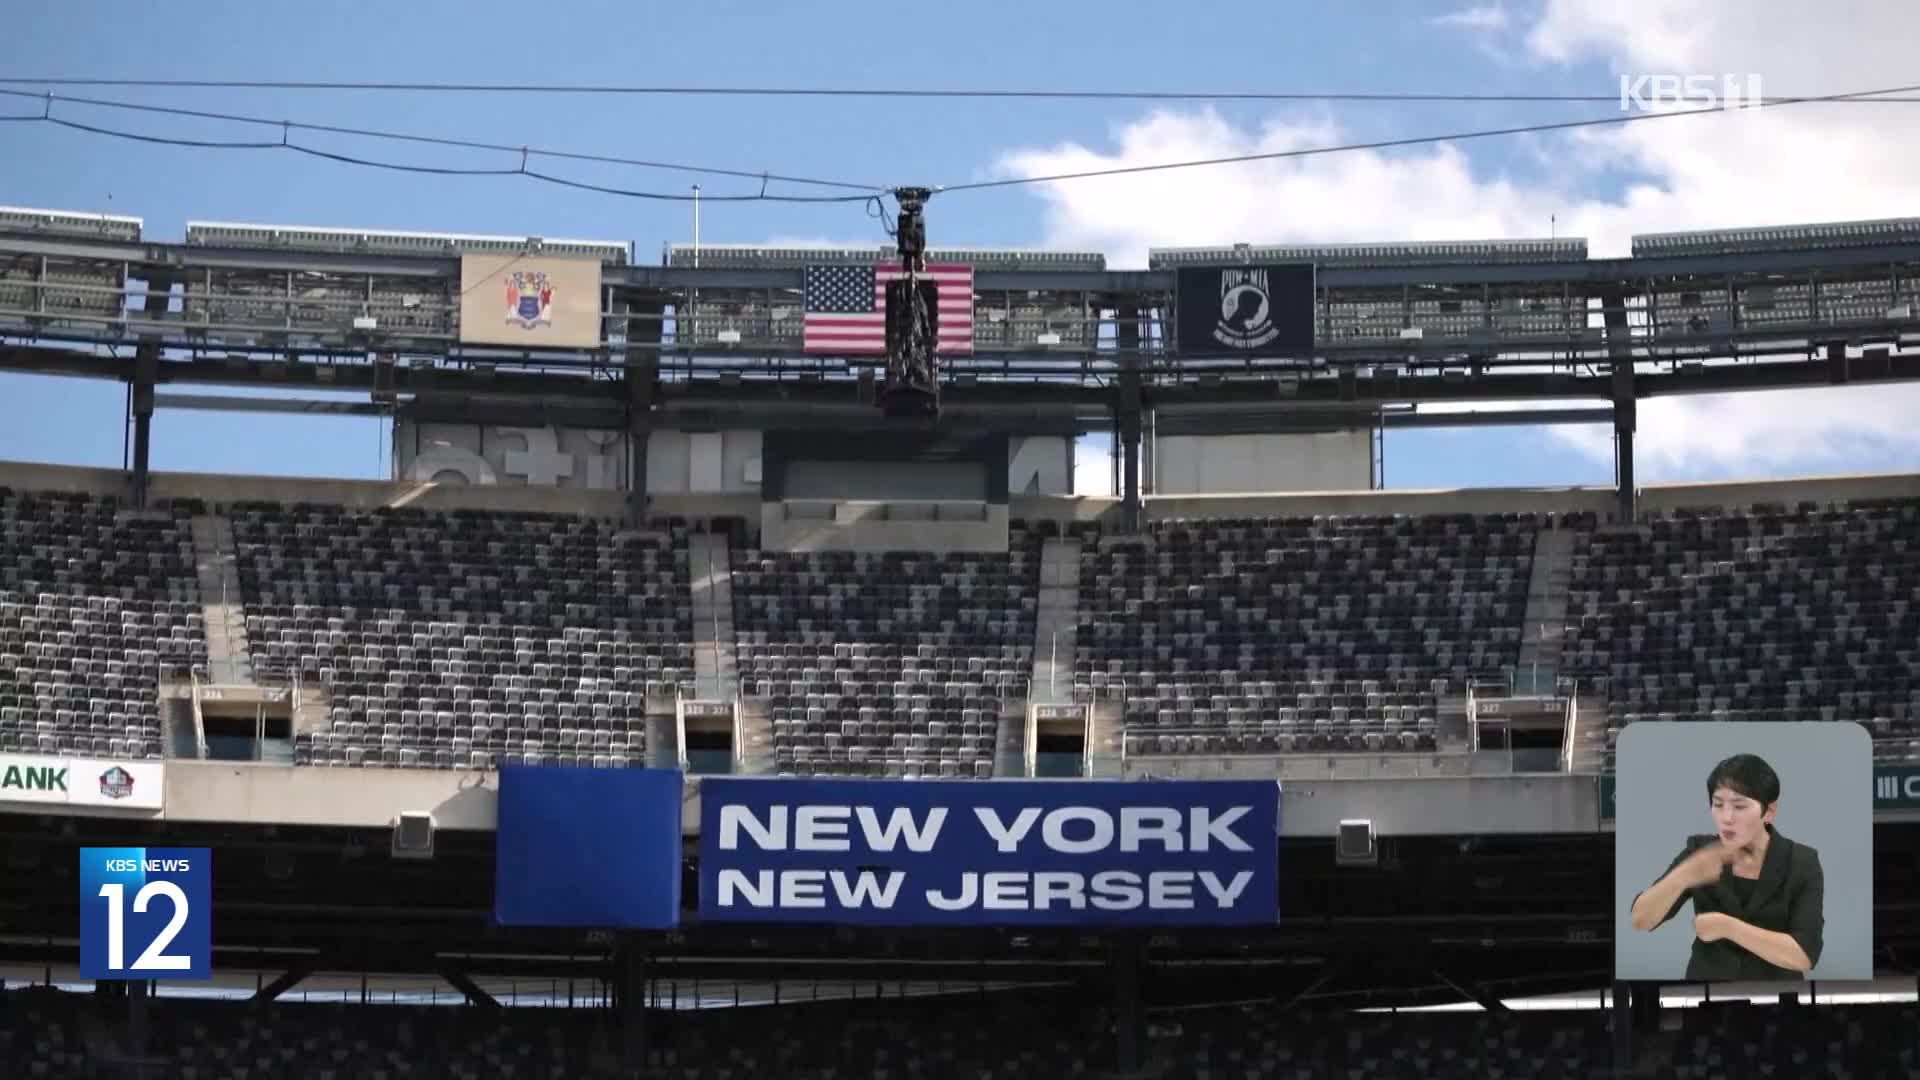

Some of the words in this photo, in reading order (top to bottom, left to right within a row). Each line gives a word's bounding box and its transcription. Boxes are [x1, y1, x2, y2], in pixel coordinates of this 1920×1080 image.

[719, 805, 949, 852] NEW
[973, 806, 1255, 854] YORK
[717, 869, 907, 908] NEW
[925, 871, 1255, 911] JERSEY
